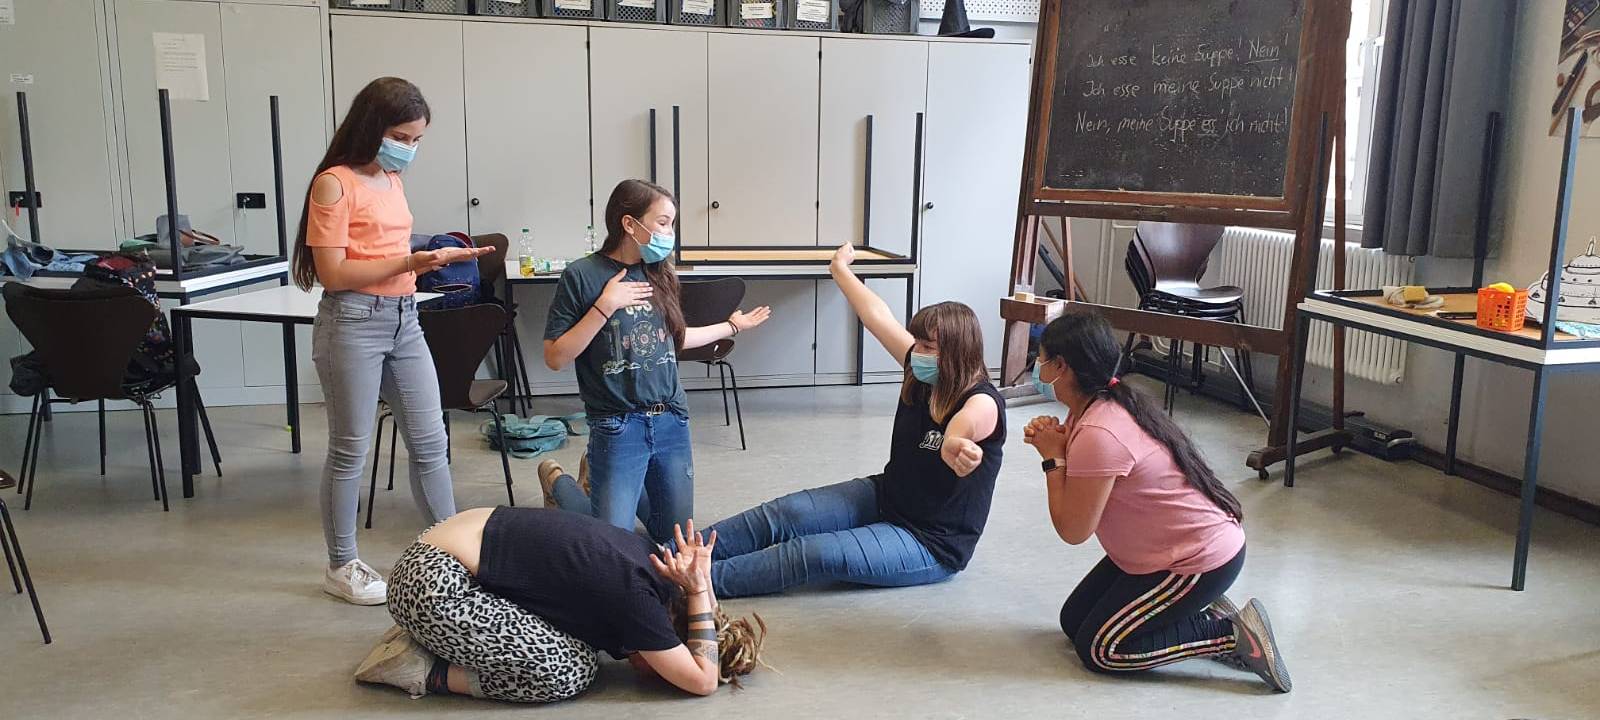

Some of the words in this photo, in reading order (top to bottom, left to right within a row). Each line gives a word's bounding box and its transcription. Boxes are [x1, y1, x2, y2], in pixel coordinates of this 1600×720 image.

[1111, 55, 1137, 66] esse
[1152, 43, 1186, 66] keine
[1082, 80, 1105, 97] Ich
[1113, 83, 1141, 97] esse
[1153, 79, 1200, 97] meine
[1208, 72, 1244, 100] Suppe
[1117, 114, 1153, 133] meine
[1159, 105, 1196, 143] Suppe
